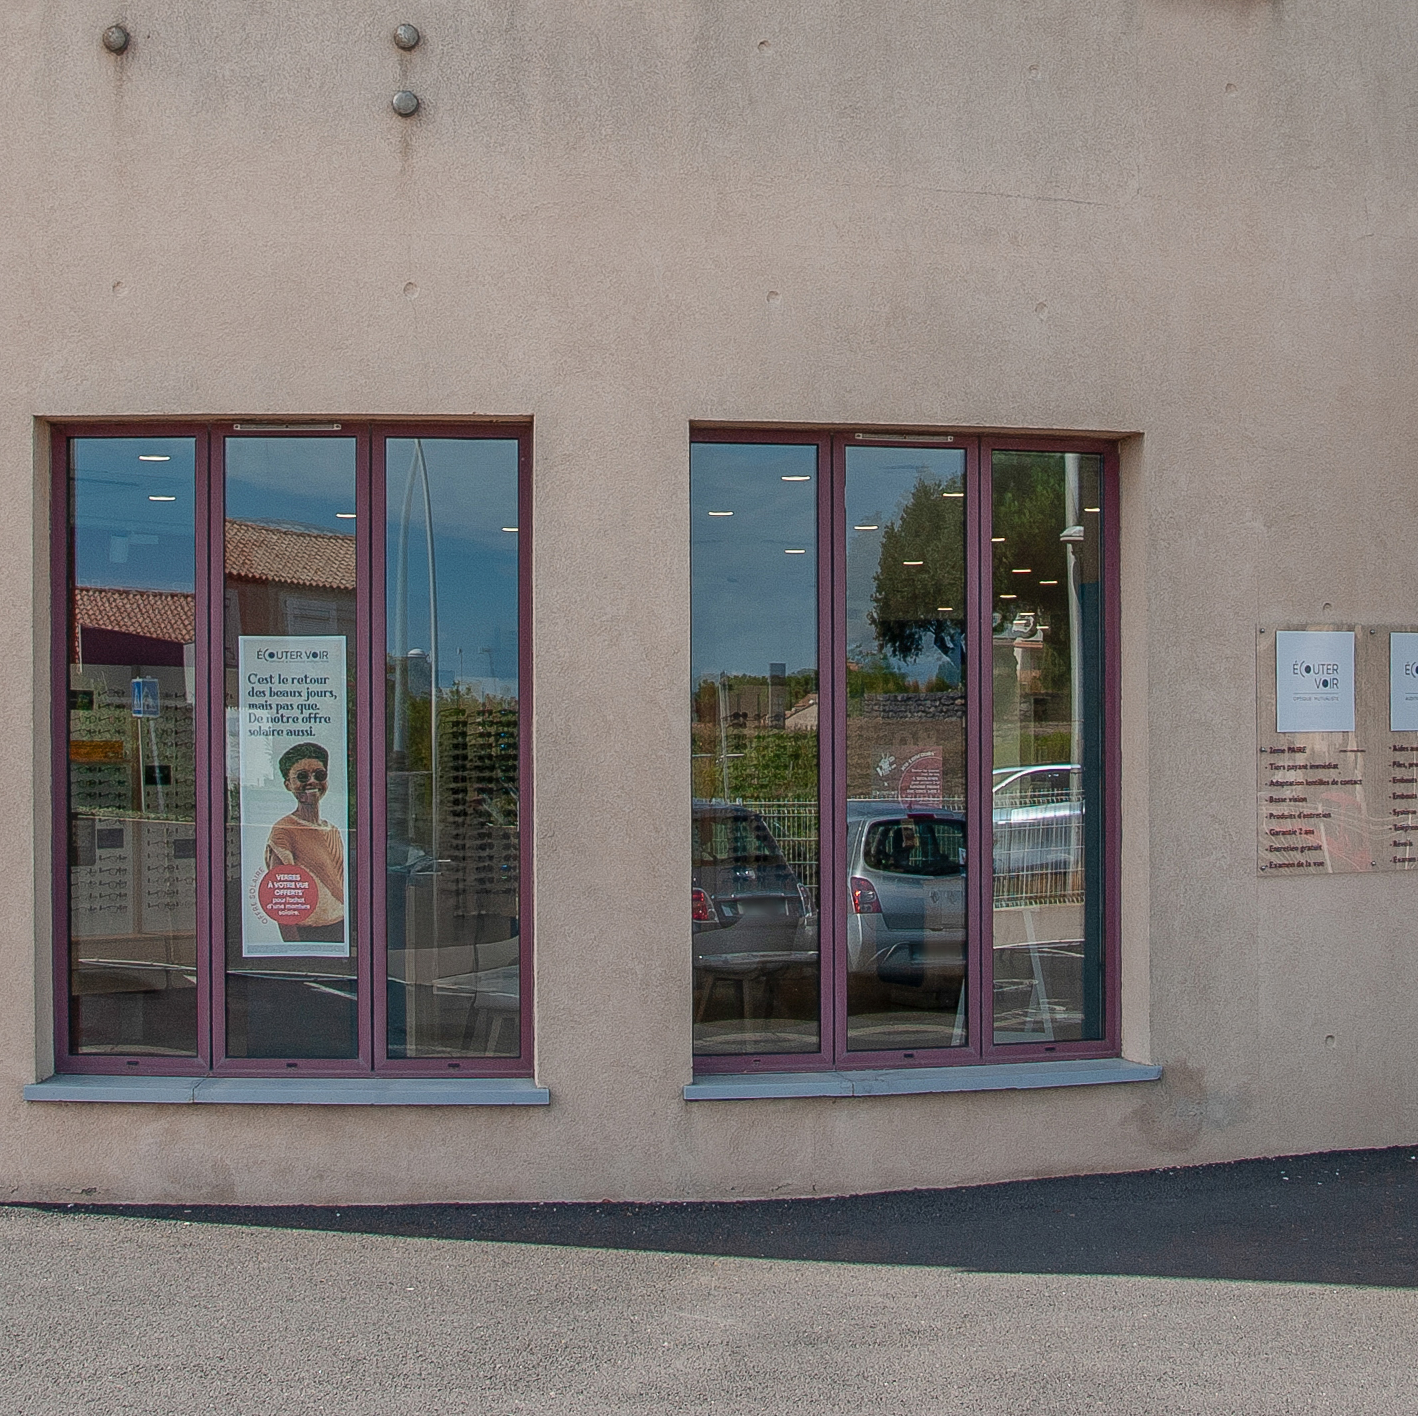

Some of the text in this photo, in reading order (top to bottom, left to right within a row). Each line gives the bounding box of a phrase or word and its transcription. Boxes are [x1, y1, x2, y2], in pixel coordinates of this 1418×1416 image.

[256, 648, 329, 662] ÉCOUTER VOIR
[1292, 660, 1339, 678] ÉCOUTER
[278, 673, 288, 685] le
[291, 674, 330, 685] retour
[1314, 678, 1340, 689] VOIR
[247, 686, 338, 701] des beaux jours,
[248, 700, 320, 714] mais pas que.
[248, 712, 331, 724] De notre offre
[248, 725, 316, 737] solaire aussi.
